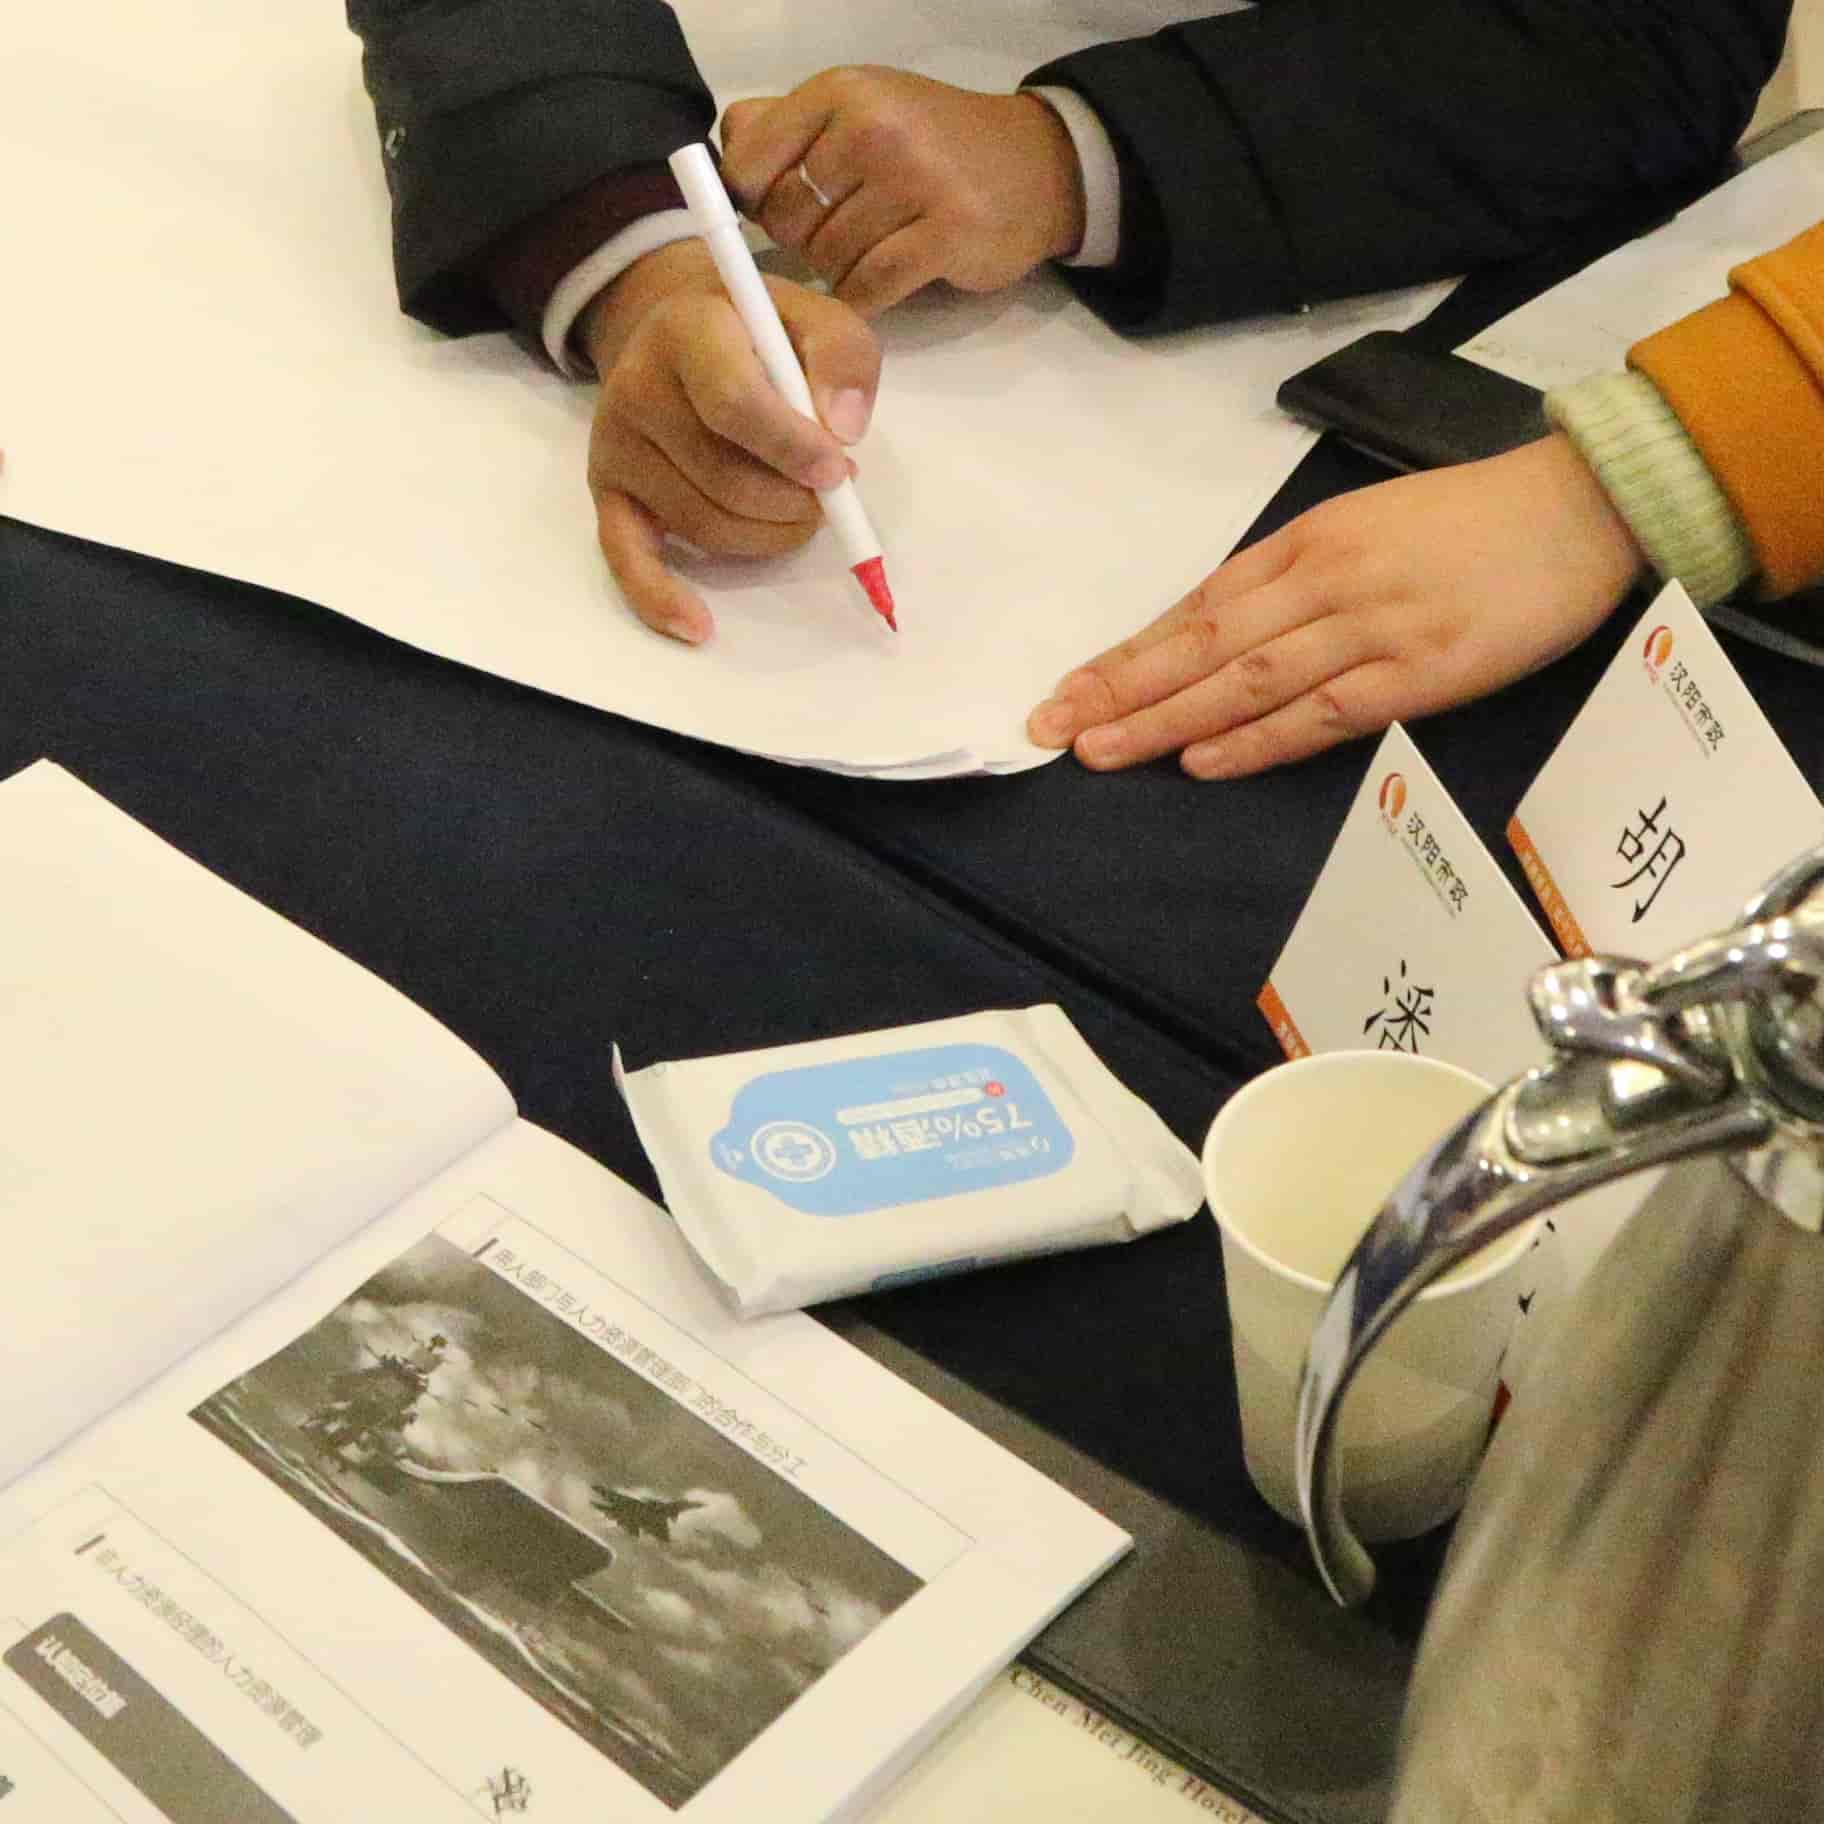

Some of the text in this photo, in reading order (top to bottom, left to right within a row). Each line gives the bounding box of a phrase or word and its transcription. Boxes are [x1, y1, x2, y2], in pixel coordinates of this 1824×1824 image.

[1668, 661, 1727, 752] 汉阳市政
[1406, 811, 1469, 912] 汉阳市政
[1609, 795, 1687, 924] 胡
